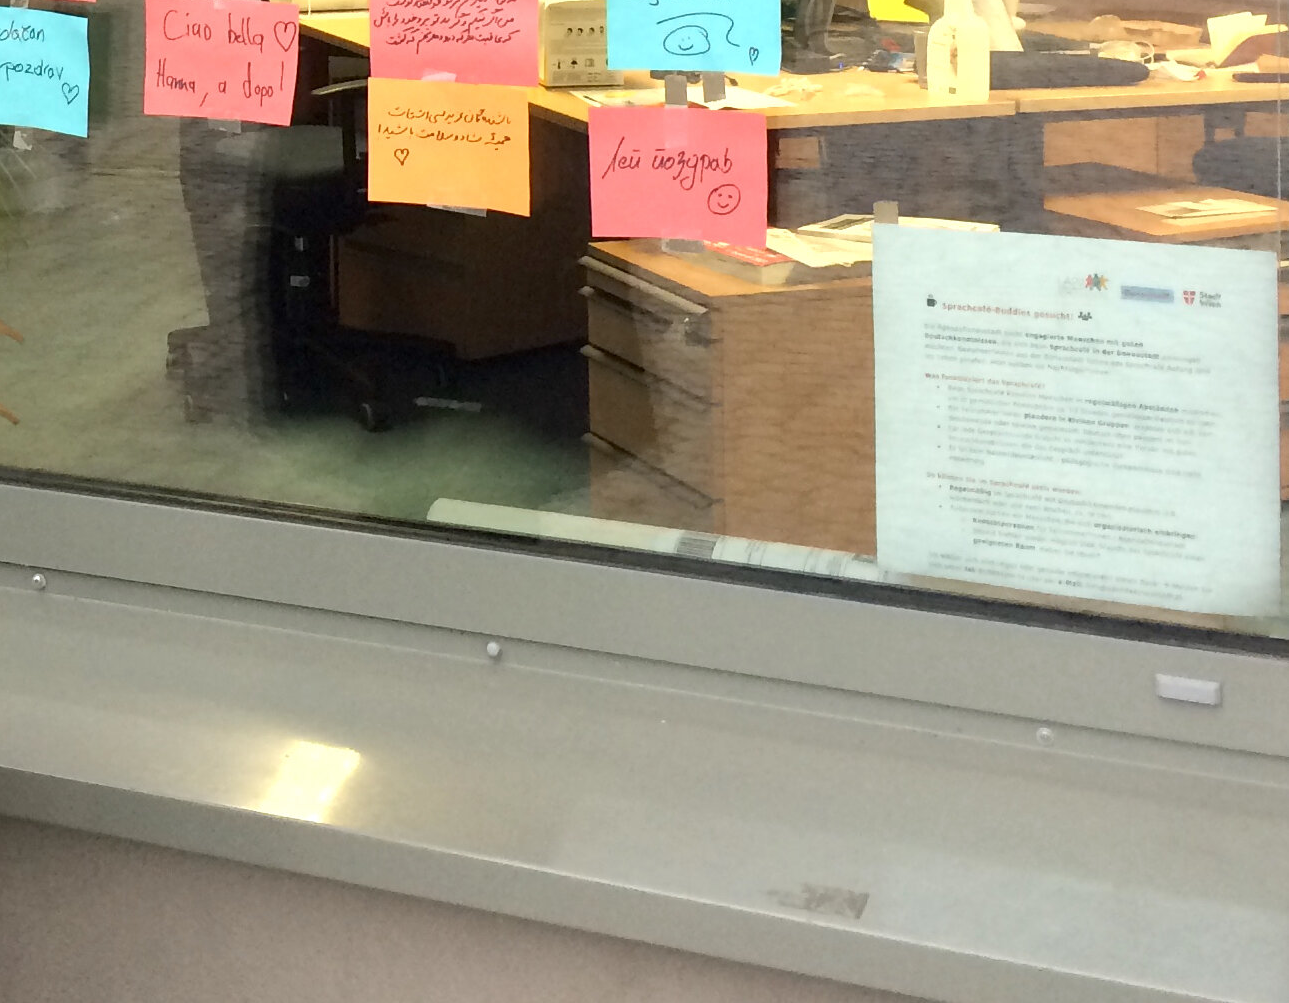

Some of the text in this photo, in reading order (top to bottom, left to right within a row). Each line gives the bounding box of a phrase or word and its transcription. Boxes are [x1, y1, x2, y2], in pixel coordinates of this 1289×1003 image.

[163, 9, 264, 53] Ciao bella
[0, 59, 64, 81] pozdrav
[218, 81, 226, 94] a
